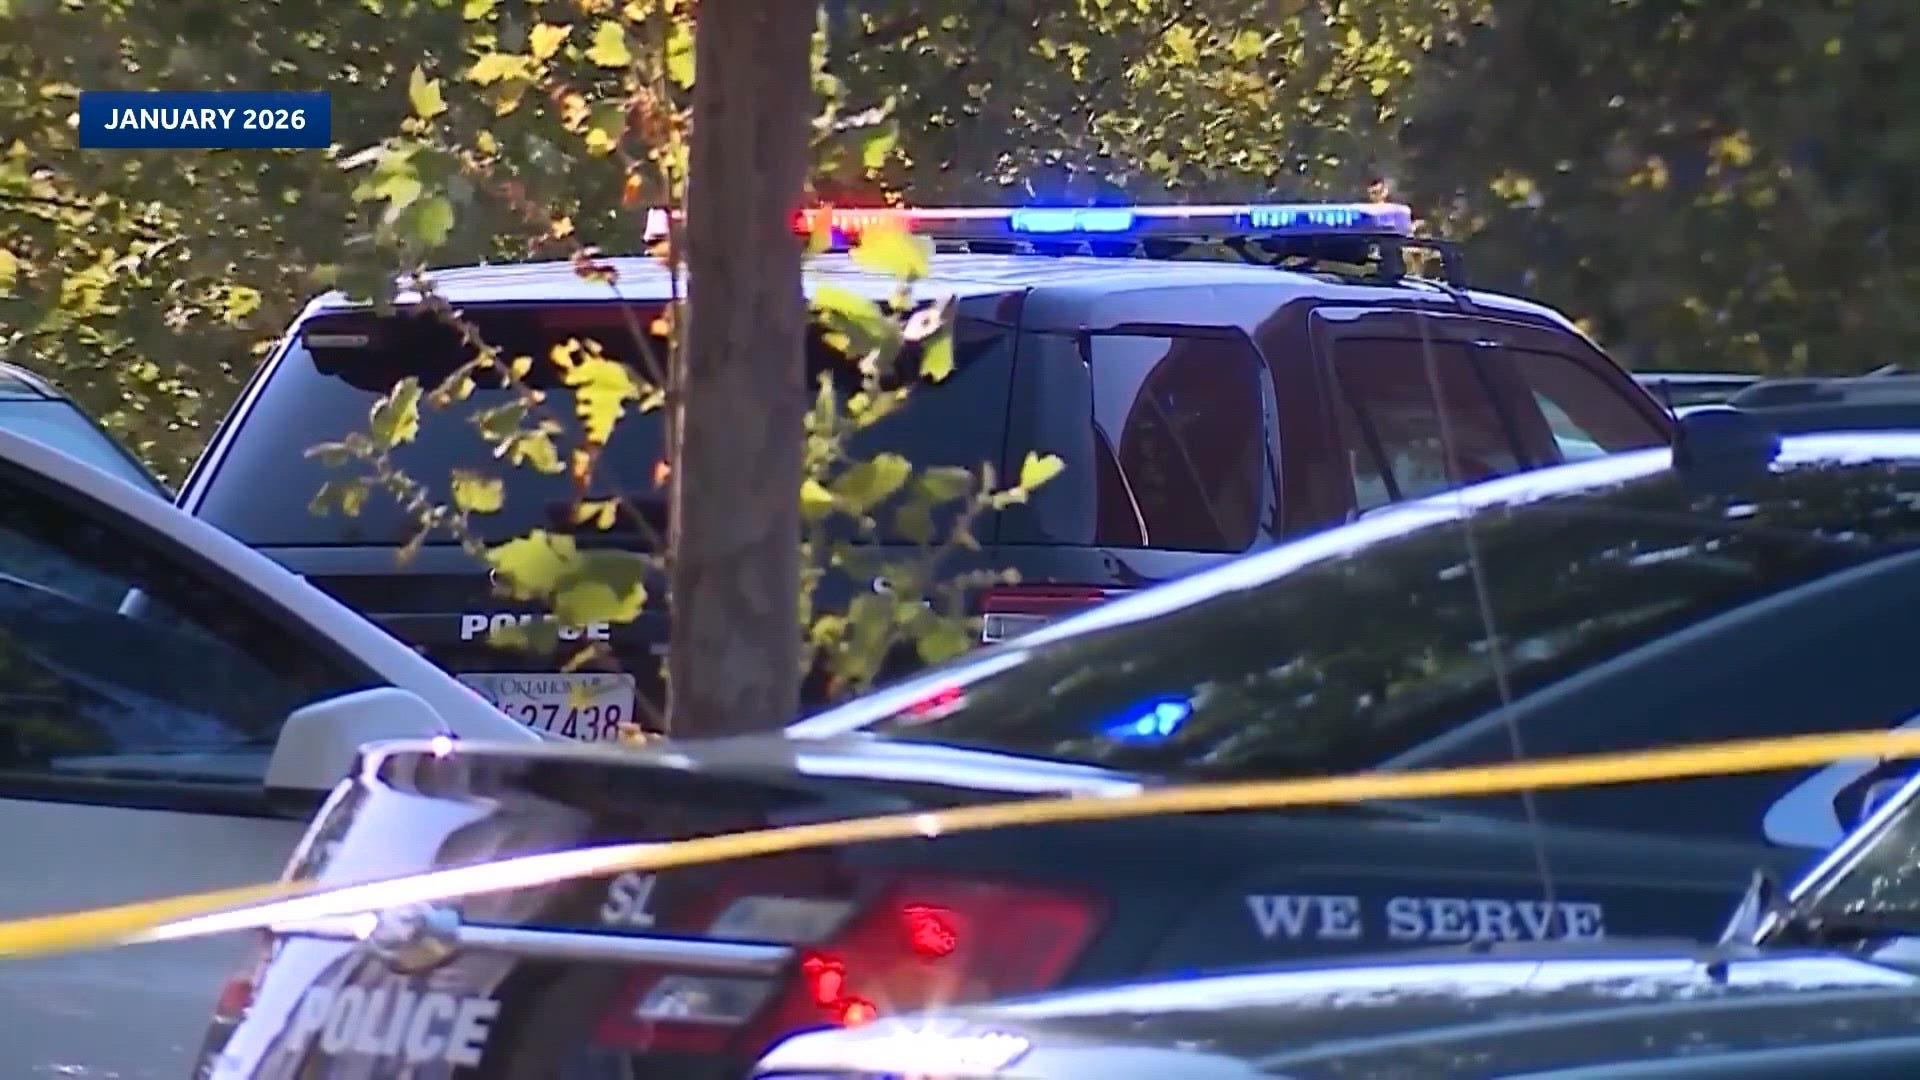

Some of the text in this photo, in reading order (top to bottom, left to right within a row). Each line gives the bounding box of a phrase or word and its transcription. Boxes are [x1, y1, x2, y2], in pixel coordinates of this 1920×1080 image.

[600, 872, 657, 926] SL
[1246, 894, 1605, 942] WE SERVE
[288, 983, 501, 1067] POLICE
